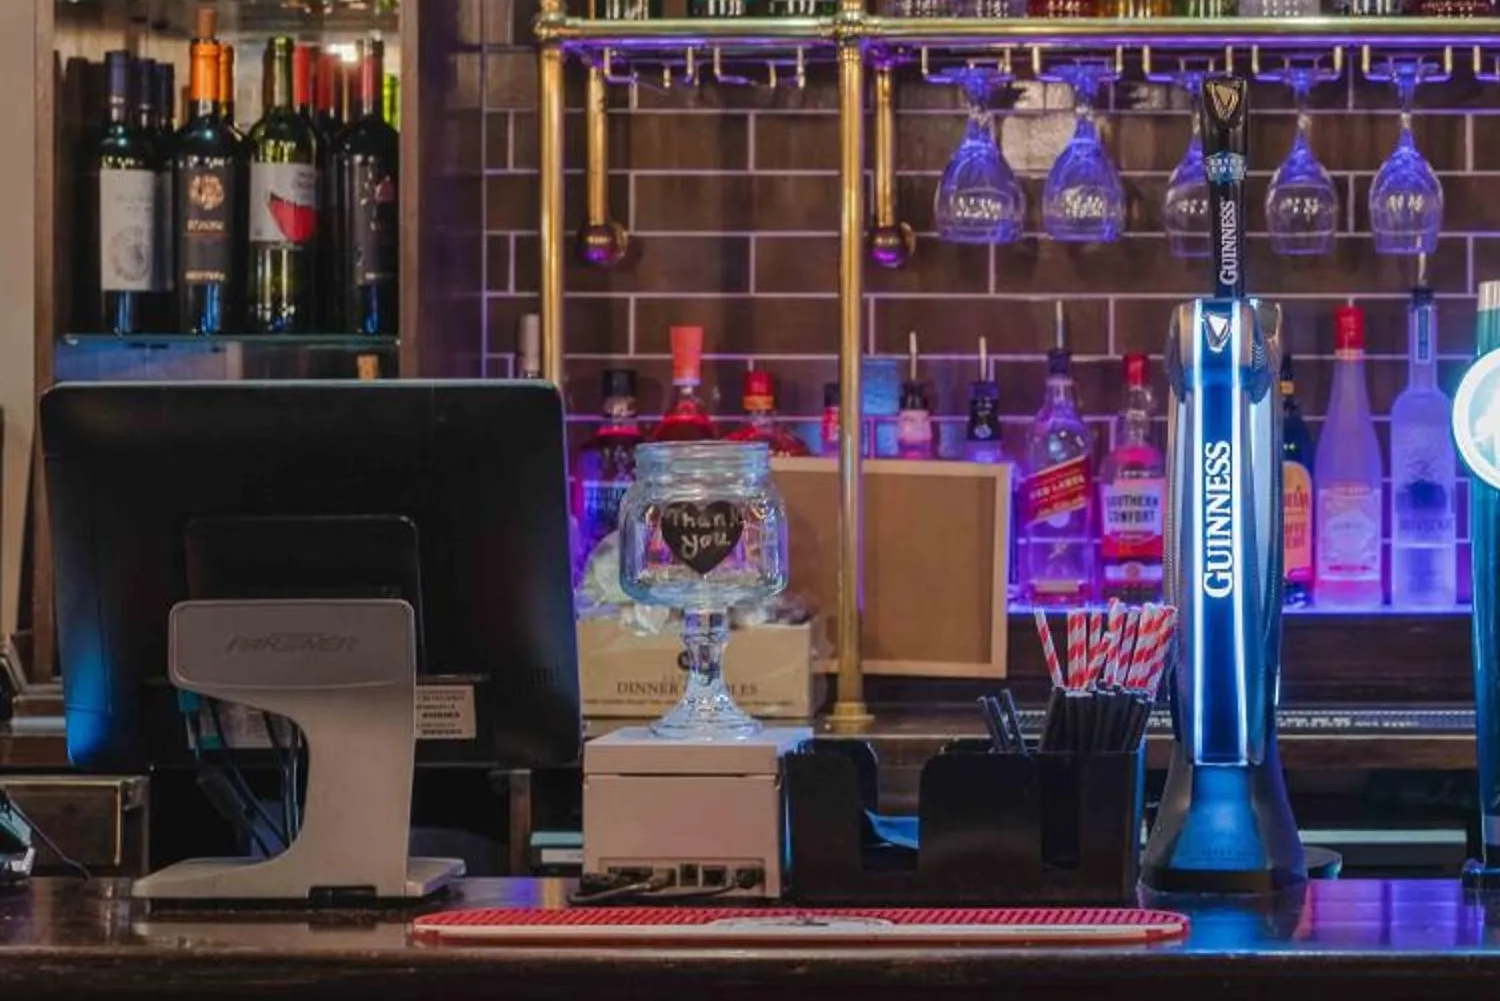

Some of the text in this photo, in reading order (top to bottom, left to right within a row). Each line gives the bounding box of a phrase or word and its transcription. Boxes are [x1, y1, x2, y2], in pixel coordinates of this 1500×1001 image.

[1219, 199, 1239, 286] GUINNESS
[1203, 437, 1235, 599] GUINNESS
[616, 680, 678, 696] DINNER
